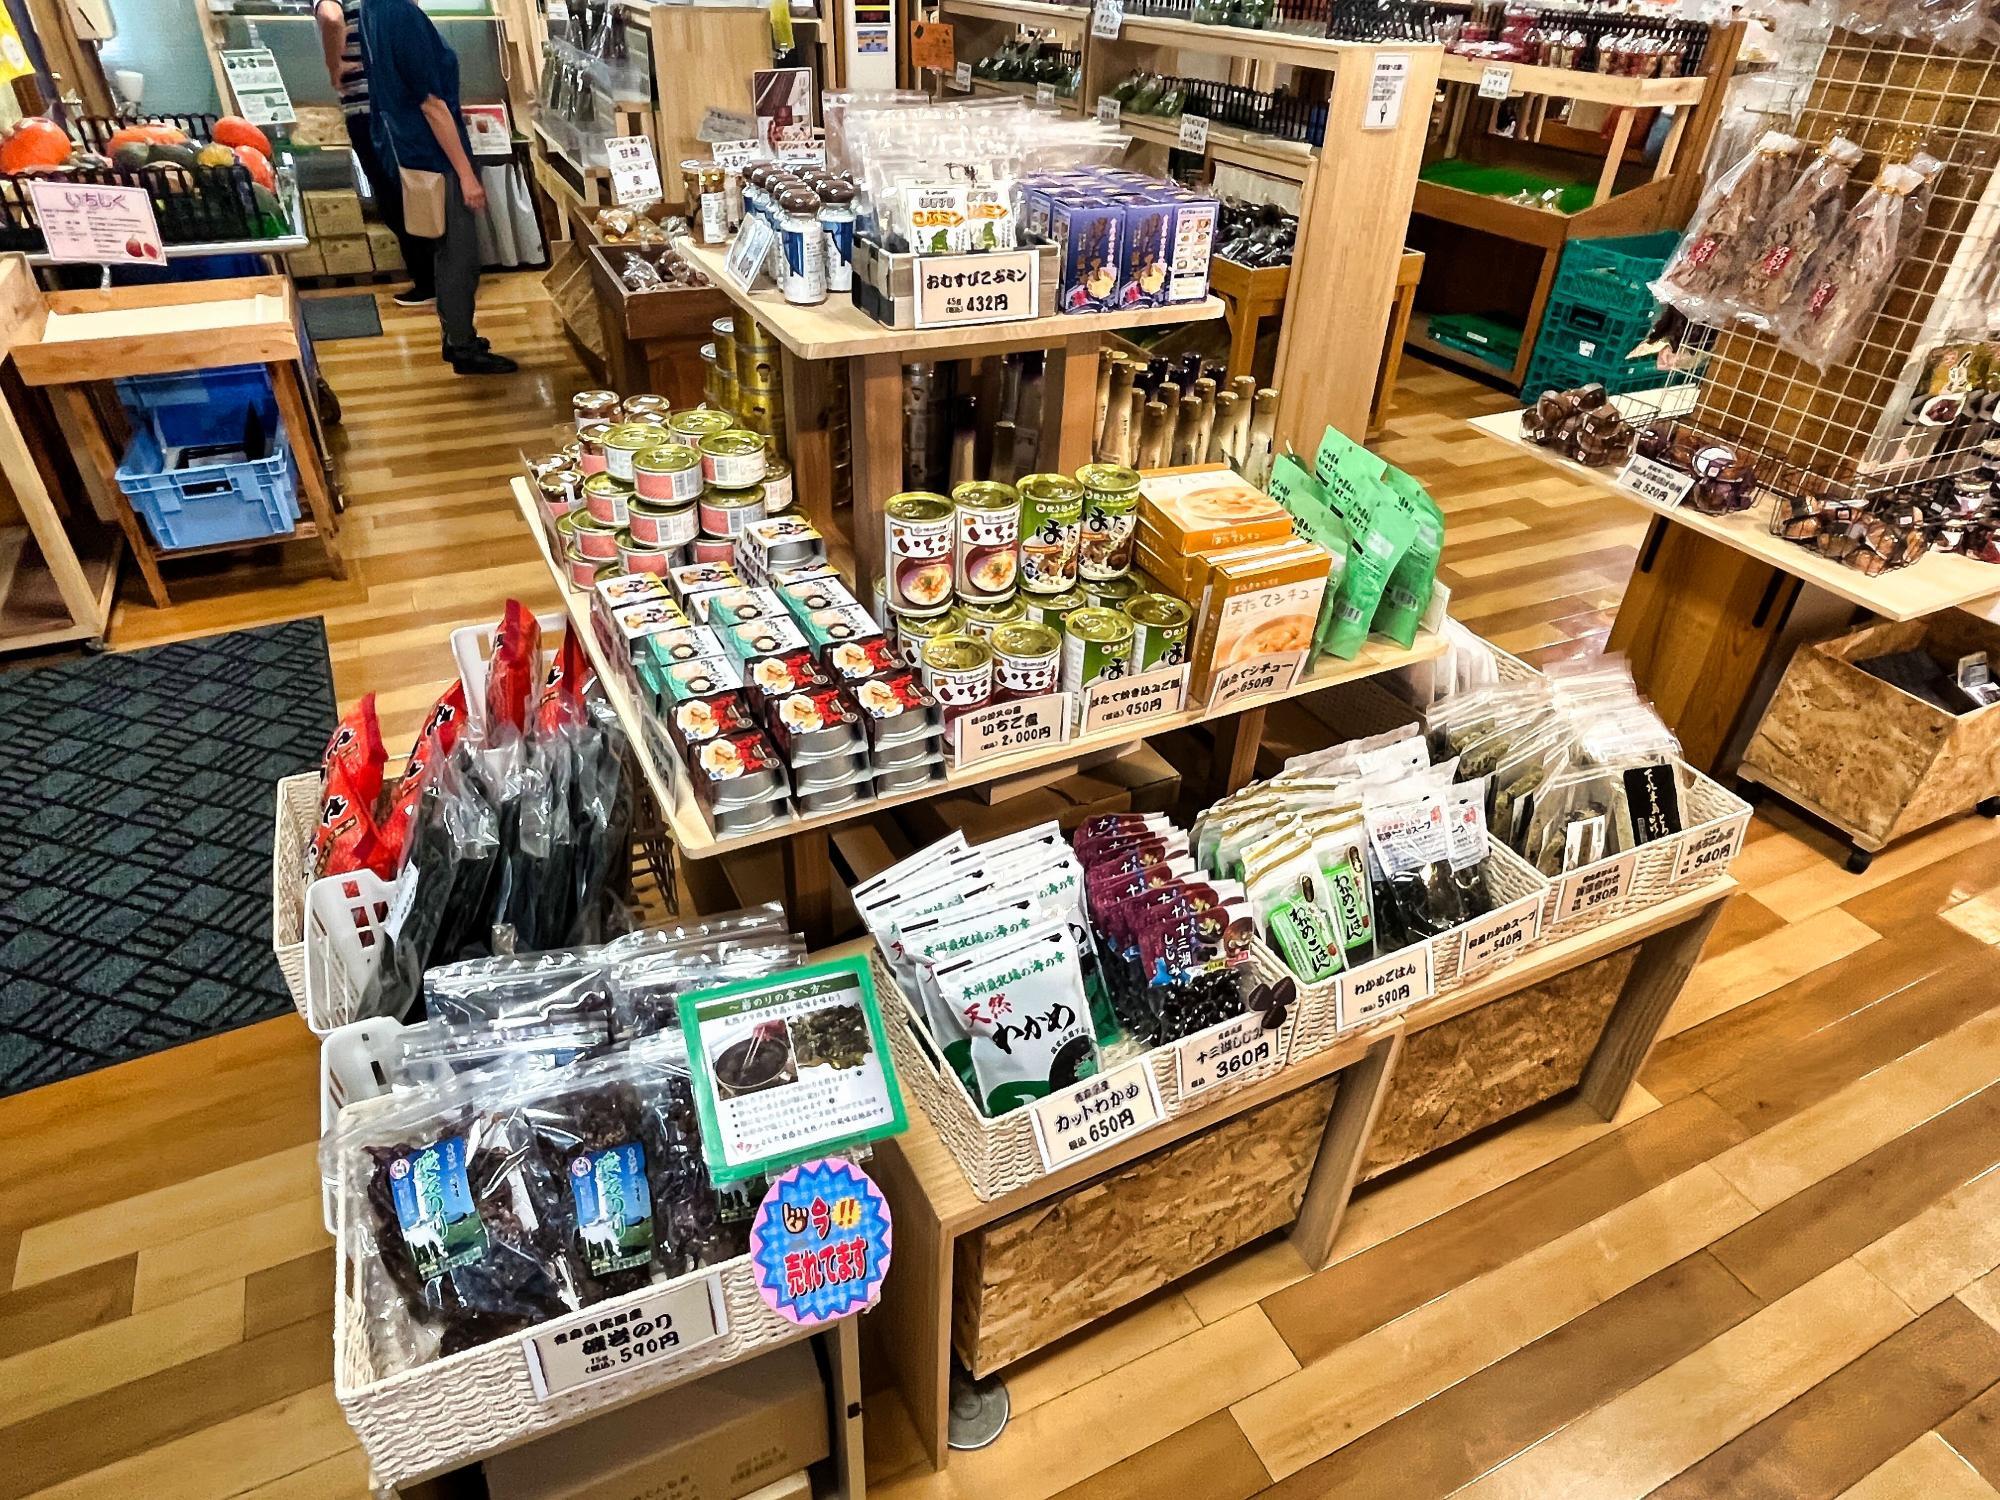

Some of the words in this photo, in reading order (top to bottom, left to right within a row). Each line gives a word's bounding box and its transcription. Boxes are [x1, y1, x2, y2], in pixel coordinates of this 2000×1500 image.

[65, 191, 129, 212] いちじく
[912, 209, 965, 227] こぶミン
[926, 269, 1027, 290] おむすびこぶミン
[966, 294, 1008, 312] 432円
[1642, 483, 1668, 501] 520円
[1219, 662, 1294, 691] ほたてシチュー
[1240, 675, 1274, 693] 650円
[1126, 698, 1162, 716] 950円
[982, 712, 1039, 737] いちご煮
[1001, 725, 1051, 747] 2,000円
[1694, 843, 1731, 868] 540円
[1586, 885, 1619, 906] 380円
[1175, 922, 1192, 968] 十三湖
[1493, 929, 1522, 952] 540円
[1164, 933, 1182, 977] しじみ
[962, 950, 1066, 1000] 本州最北端の海の幸
[1354, 963, 1417, 996] わかめごはん
[1377, 984, 1410, 1008] 590円
[963, 993, 1013, 1028] 天然
[991, 1002, 1076, 1055] わかめ
[1215, 1041, 1269, 1079] 360円
[1055, 1083, 1139, 1133] カットわかめ
[1088, 1107, 1135, 1142] 650円
[782, 1236, 869, 1299] 売れてます
[619, 1330, 680, 1364] 590円
